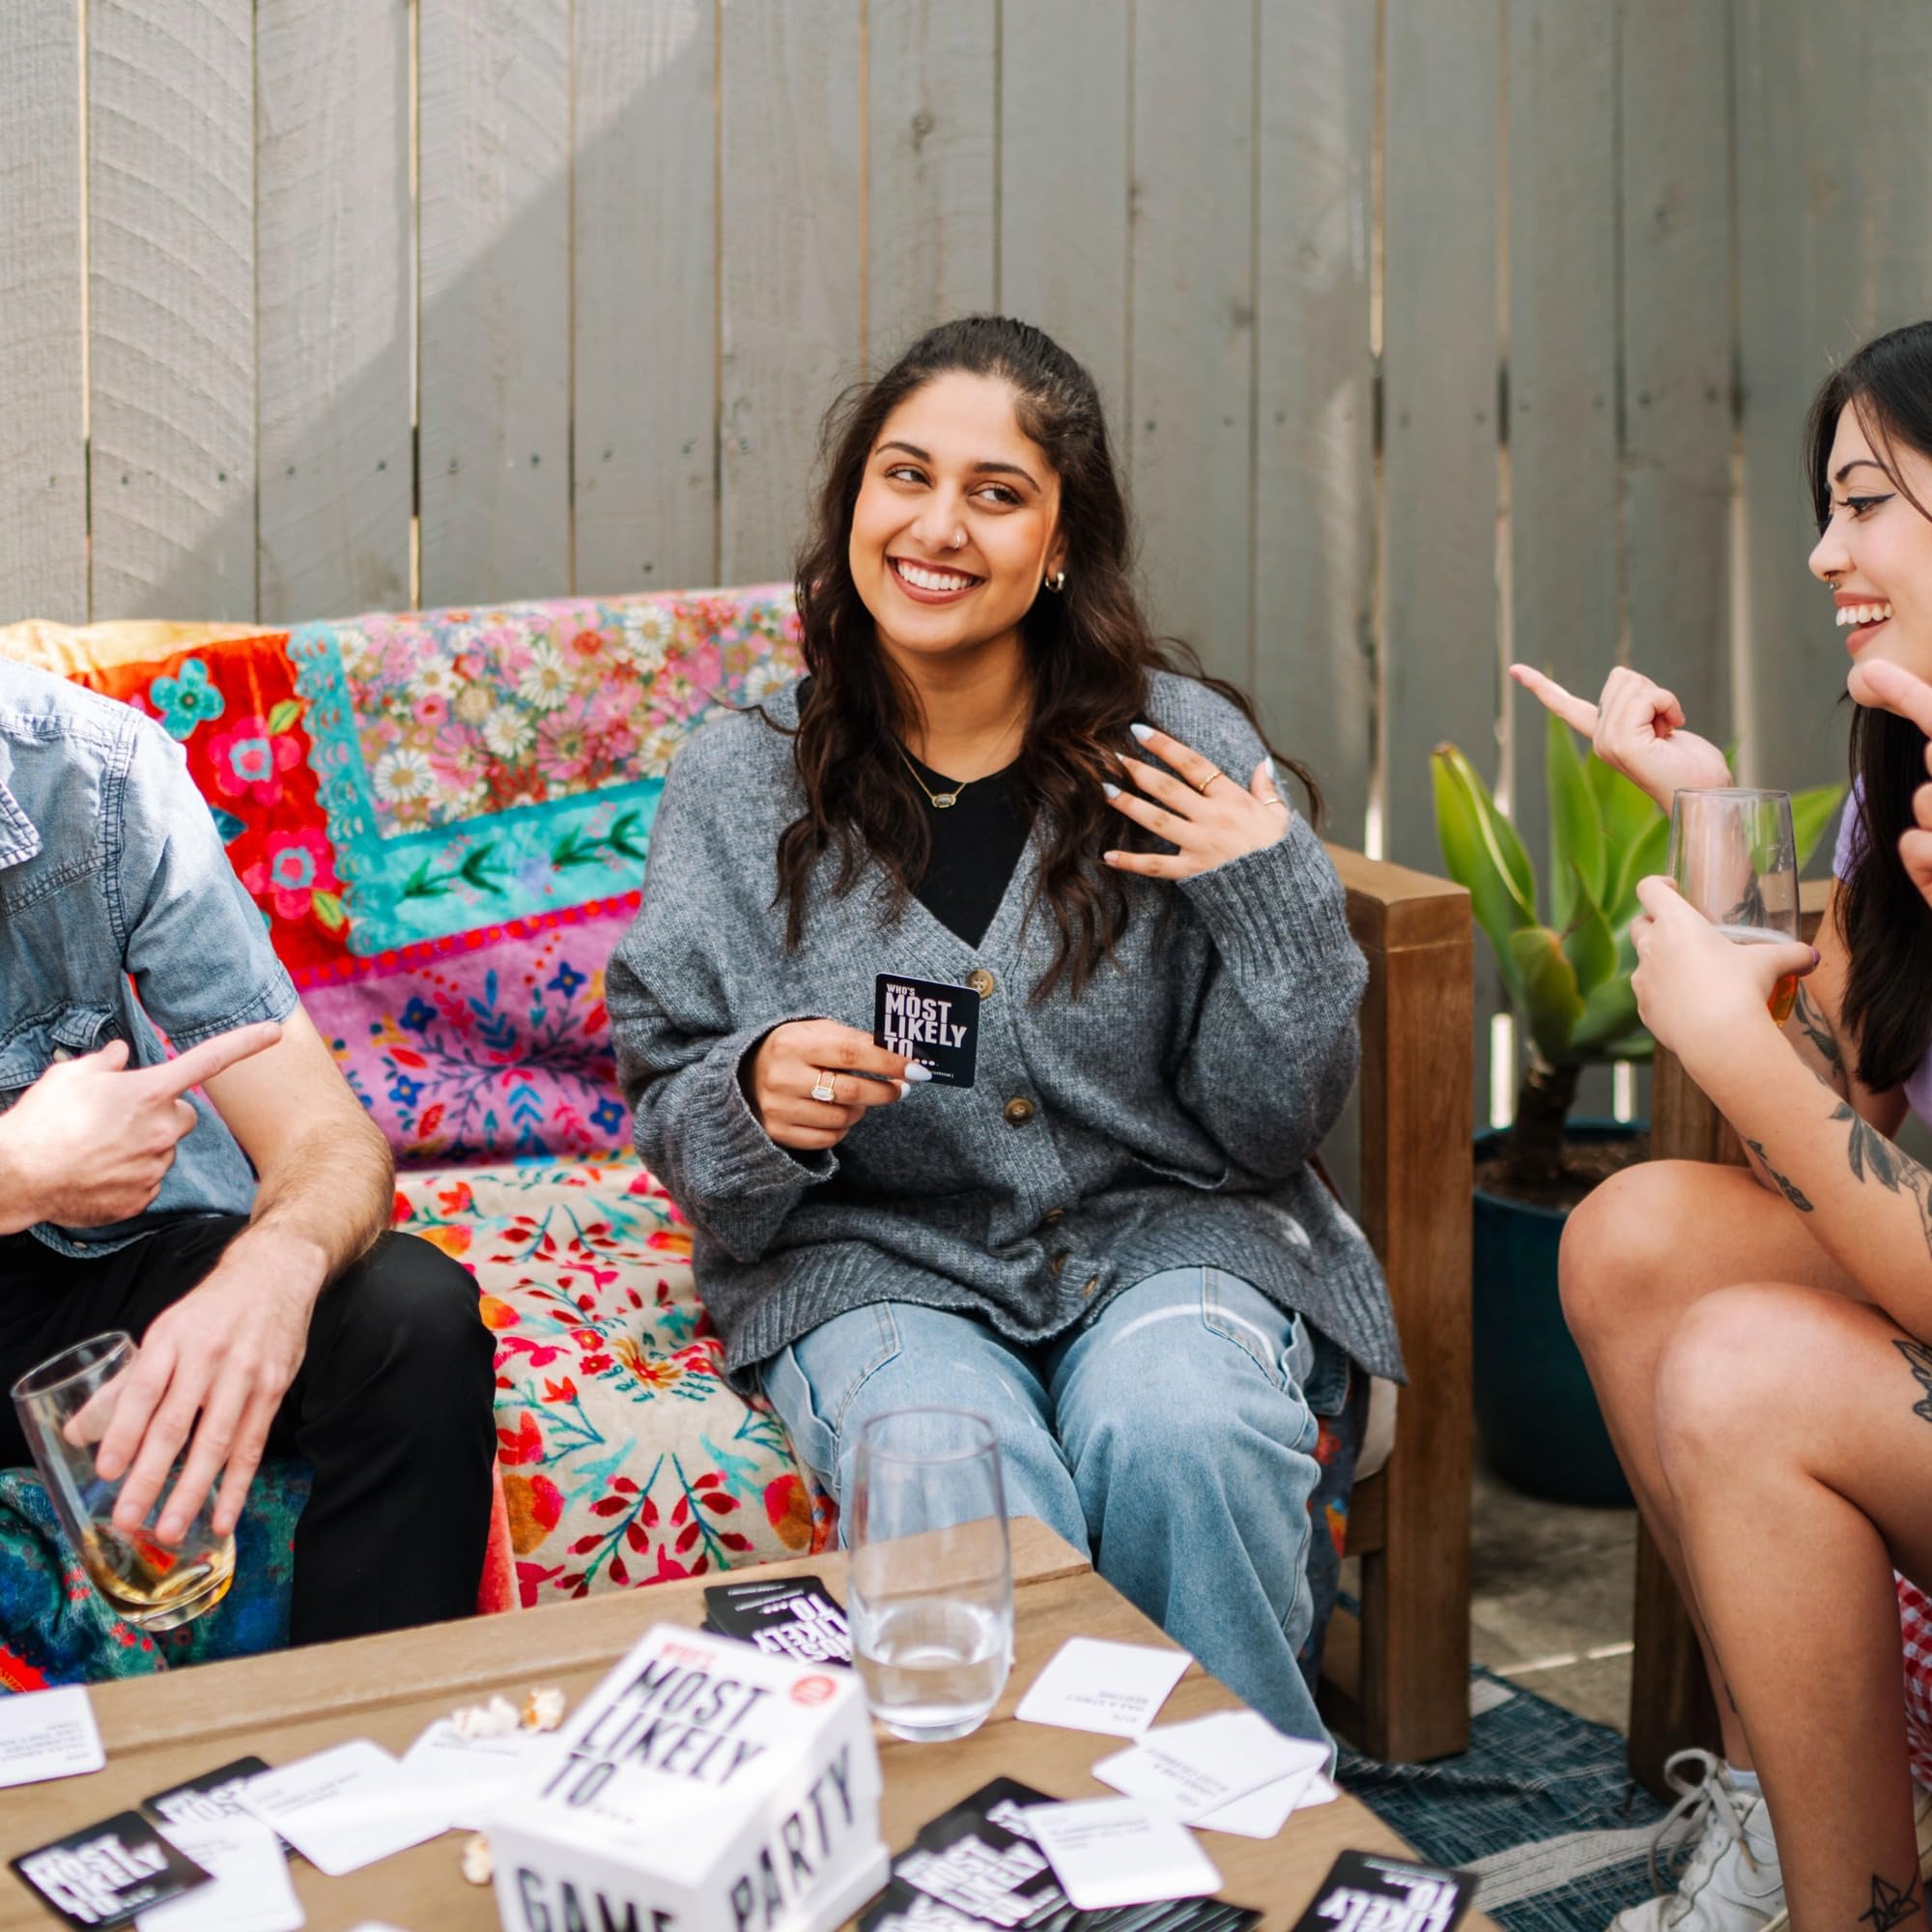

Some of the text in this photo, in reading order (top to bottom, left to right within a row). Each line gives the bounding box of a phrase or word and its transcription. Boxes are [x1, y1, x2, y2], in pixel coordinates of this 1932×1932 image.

[885, 992, 952, 1023] MOST
[886, 983, 916, 996] WHO'S
[884, 1013, 967, 1048] LIKELY
[752, 1607, 850, 1655] LIKELY
[615, 1660, 774, 1734] MOST
[572, 1703, 766, 1786] LIKELY
[730, 1744, 853, 1932] PARTY
